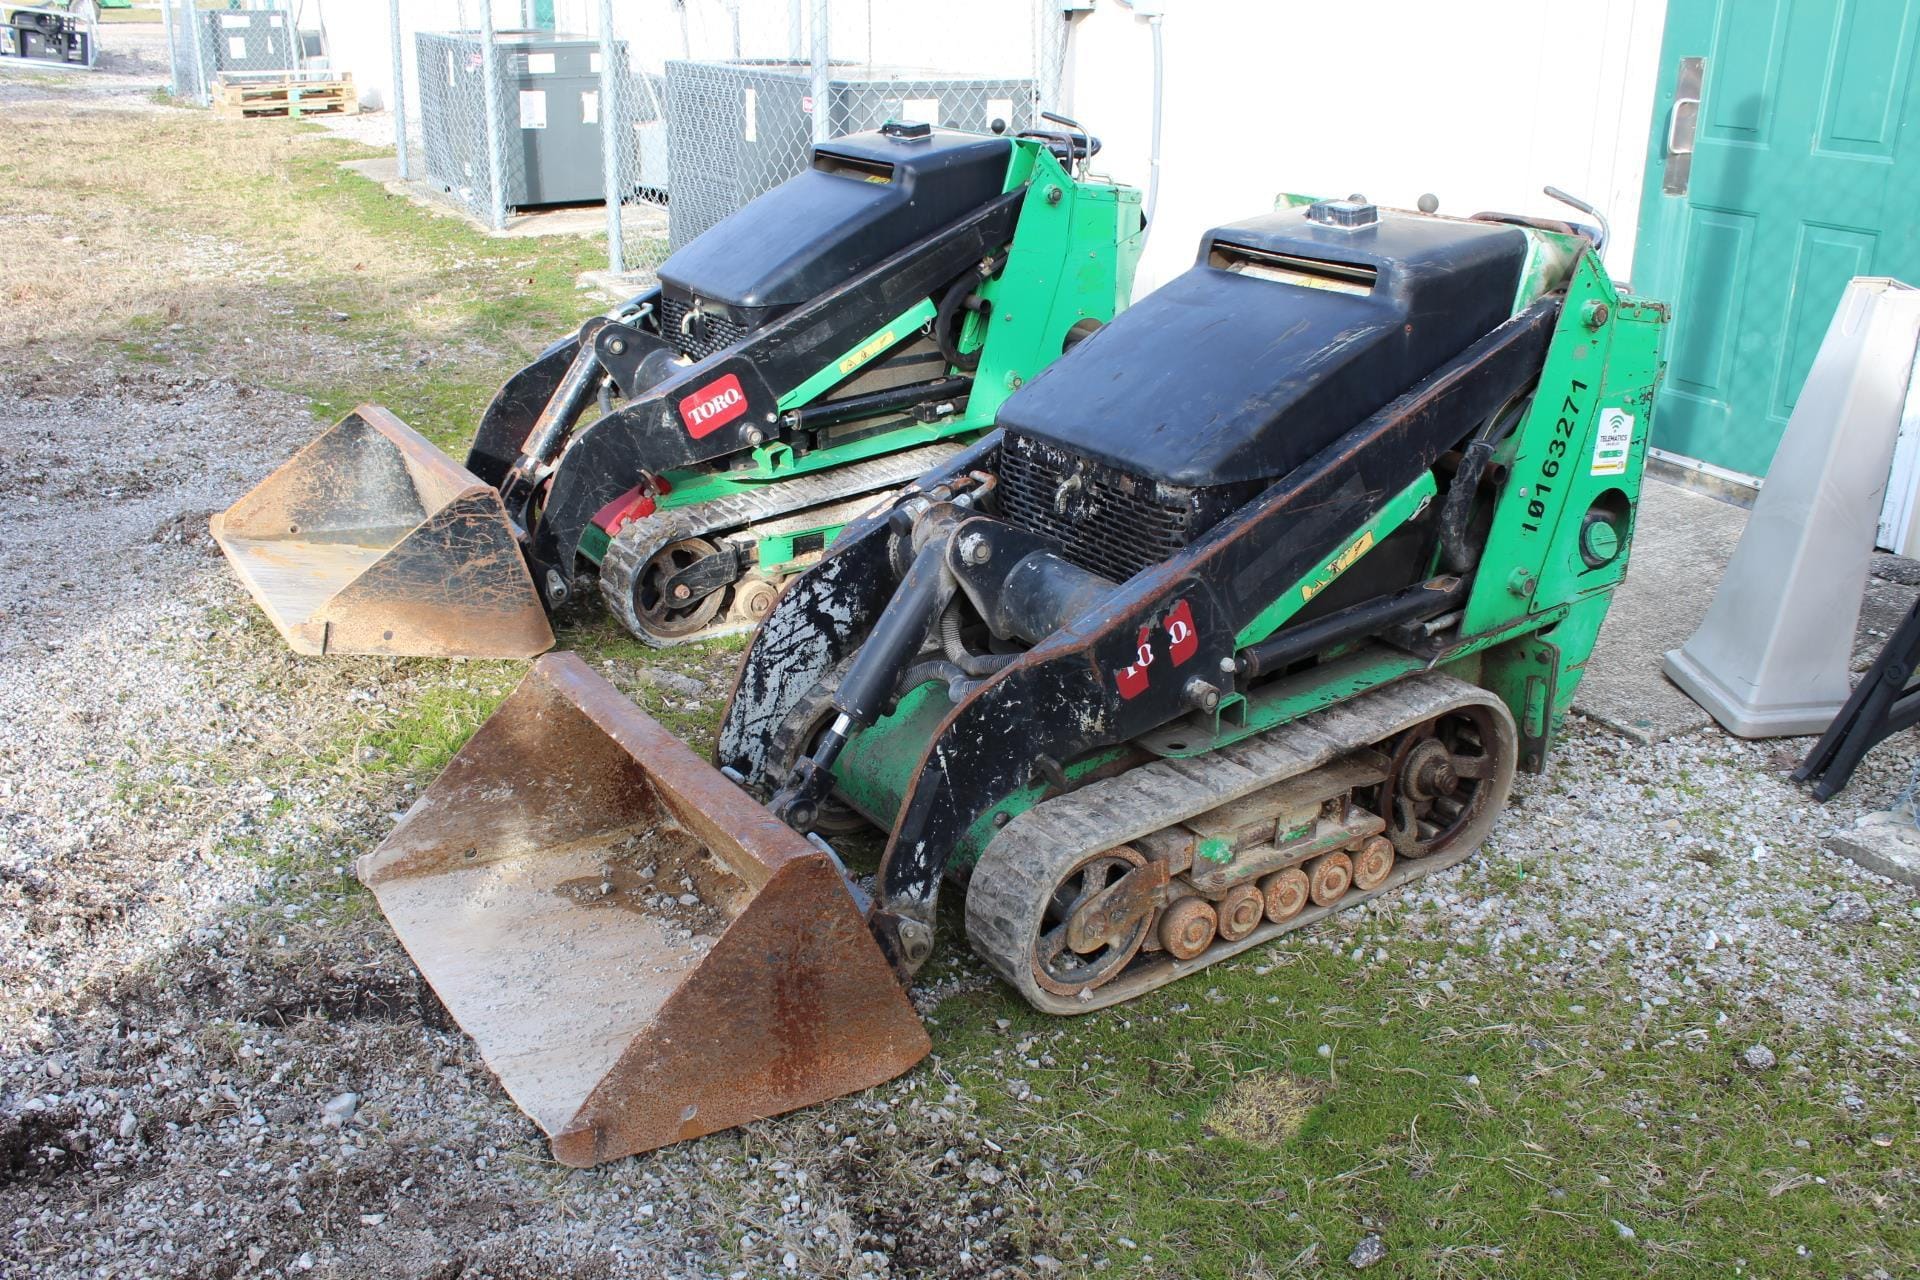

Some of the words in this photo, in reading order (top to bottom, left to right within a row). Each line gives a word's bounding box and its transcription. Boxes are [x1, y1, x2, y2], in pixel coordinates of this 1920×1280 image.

[687, 388, 740, 426] TORO
[1521, 378, 1588, 534] 10163271
[1600, 434, 1628, 442] TELEMATICS
